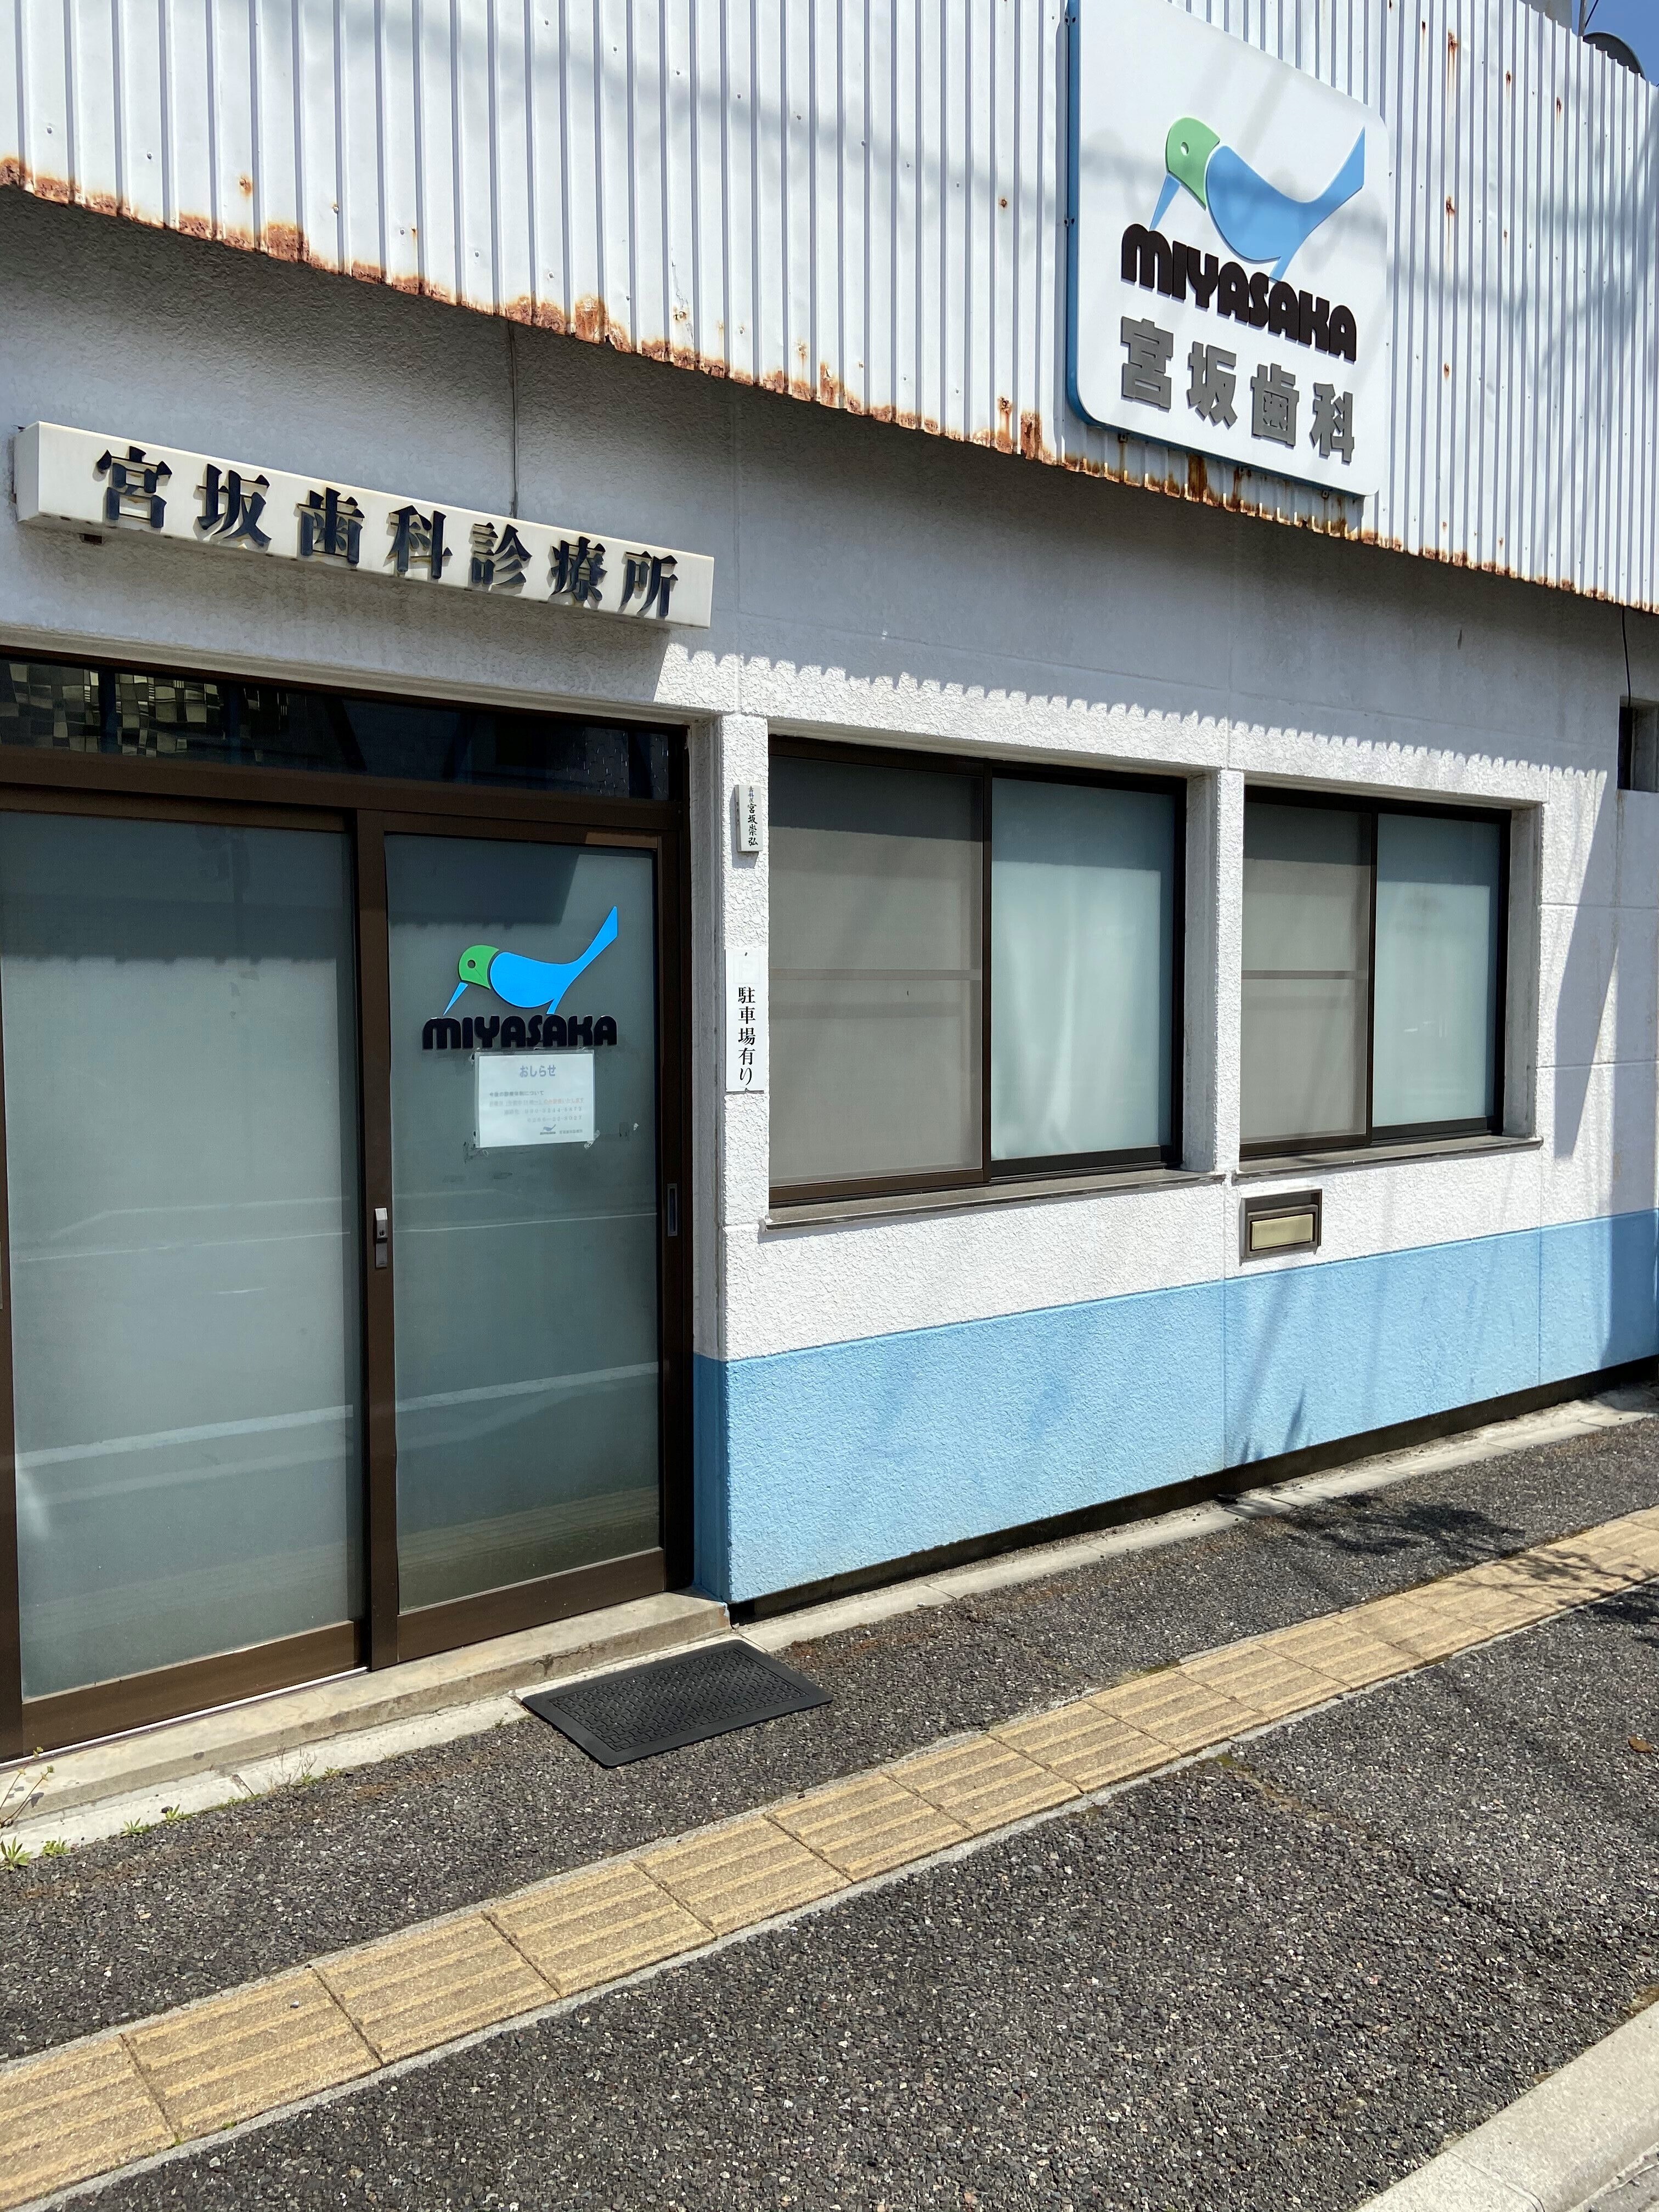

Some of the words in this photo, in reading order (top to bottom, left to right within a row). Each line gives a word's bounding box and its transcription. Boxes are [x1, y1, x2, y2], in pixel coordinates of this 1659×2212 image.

[1121, 223, 1357, 362] MIYASAKA
[1121, 316, 1355, 464] 宮坂歯科
[96, 446, 680, 618] 宮坂歯科診療所
[422, 1015, 618, 1050] MIYASAKA
[520, 1065, 556, 1078] おしらせ
[738, 986, 755, 1086] 駐車場有り
